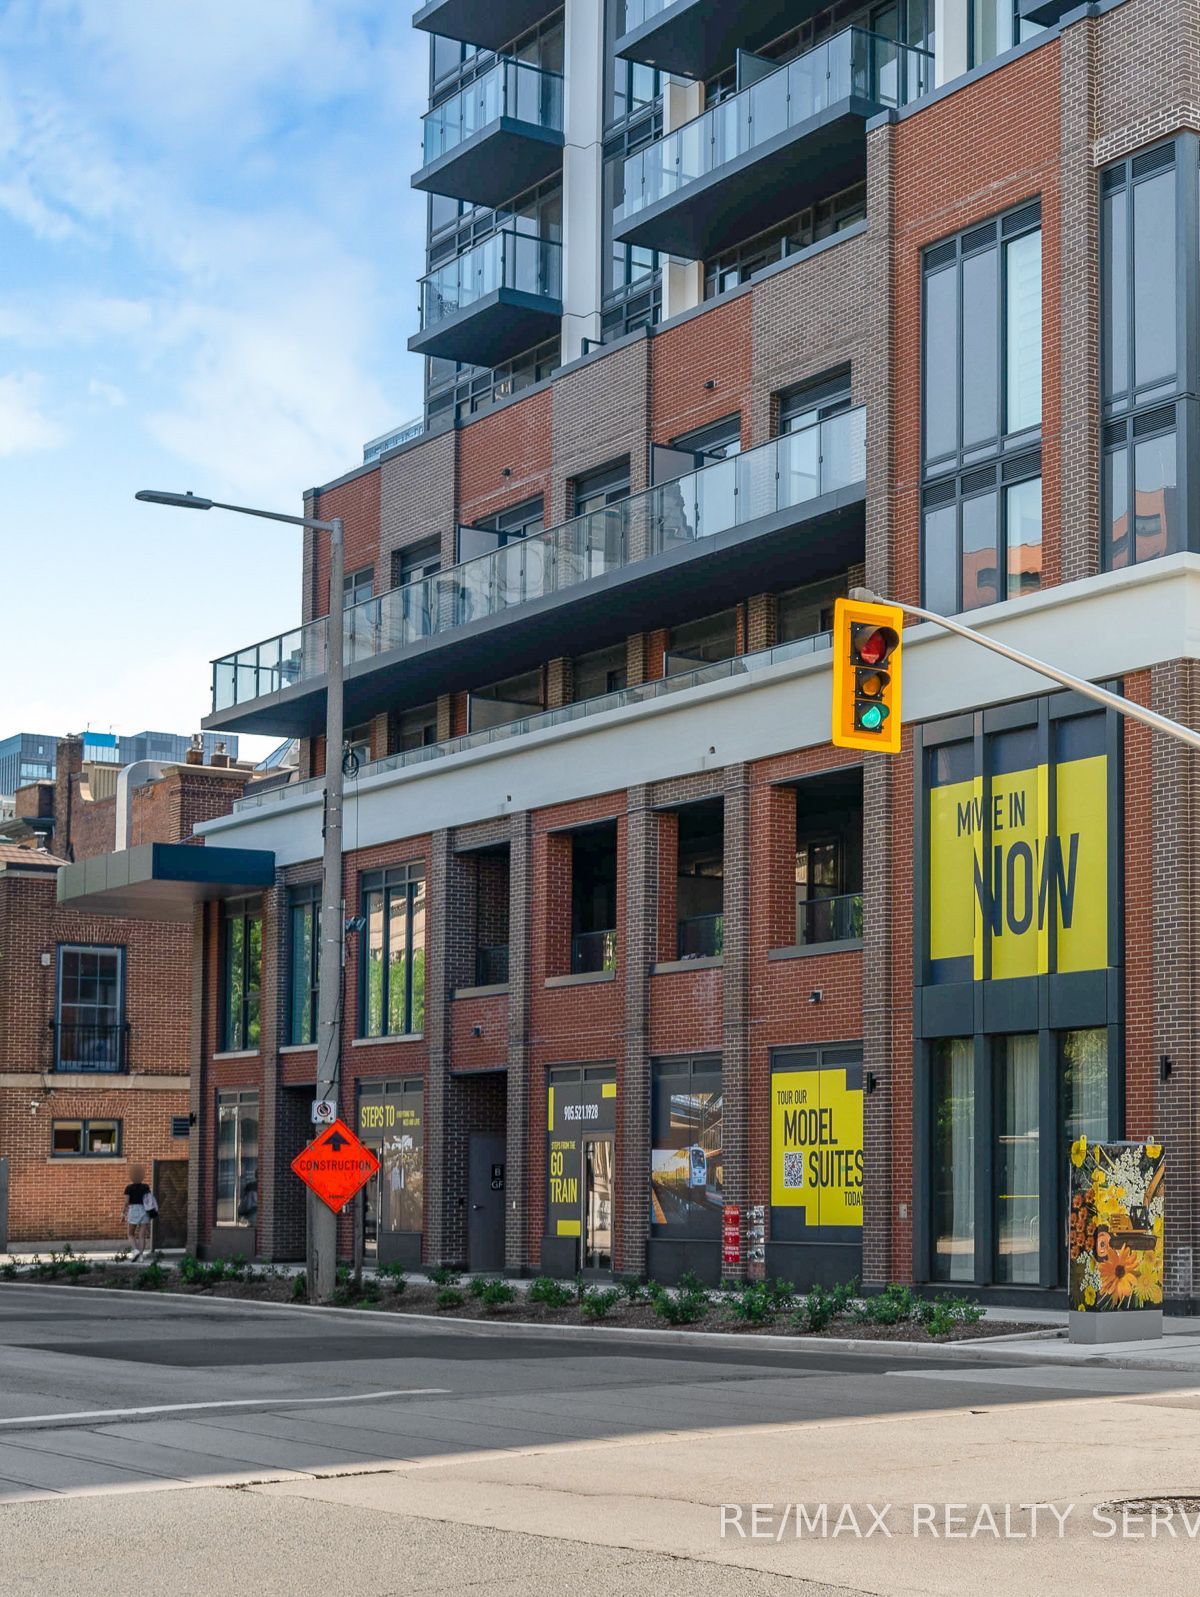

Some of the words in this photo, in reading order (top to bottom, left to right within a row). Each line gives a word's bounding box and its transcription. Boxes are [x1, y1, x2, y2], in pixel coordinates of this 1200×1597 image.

[957, 795, 1004, 837] MVE
[1009, 790, 1025, 829] IN
[974, 833, 1079, 938] NOW
[777, 1090, 793, 1105] TOUR
[794, 1089, 807, 1104] OUR
[361, 1106, 384, 1128] STEPS
[385, 1105, 395, 1127] TO
[564, 1104, 599, 1120] 905.521.1928
[784, 1108, 838, 1146] MODEL
[300, 1160, 371, 1171] CONSTRUCTION
[551, 1151, 563, 1176] GO
[808, 1149, 863, 1188] SUITES
[550, 1178, 578, 1203] TRAIN
